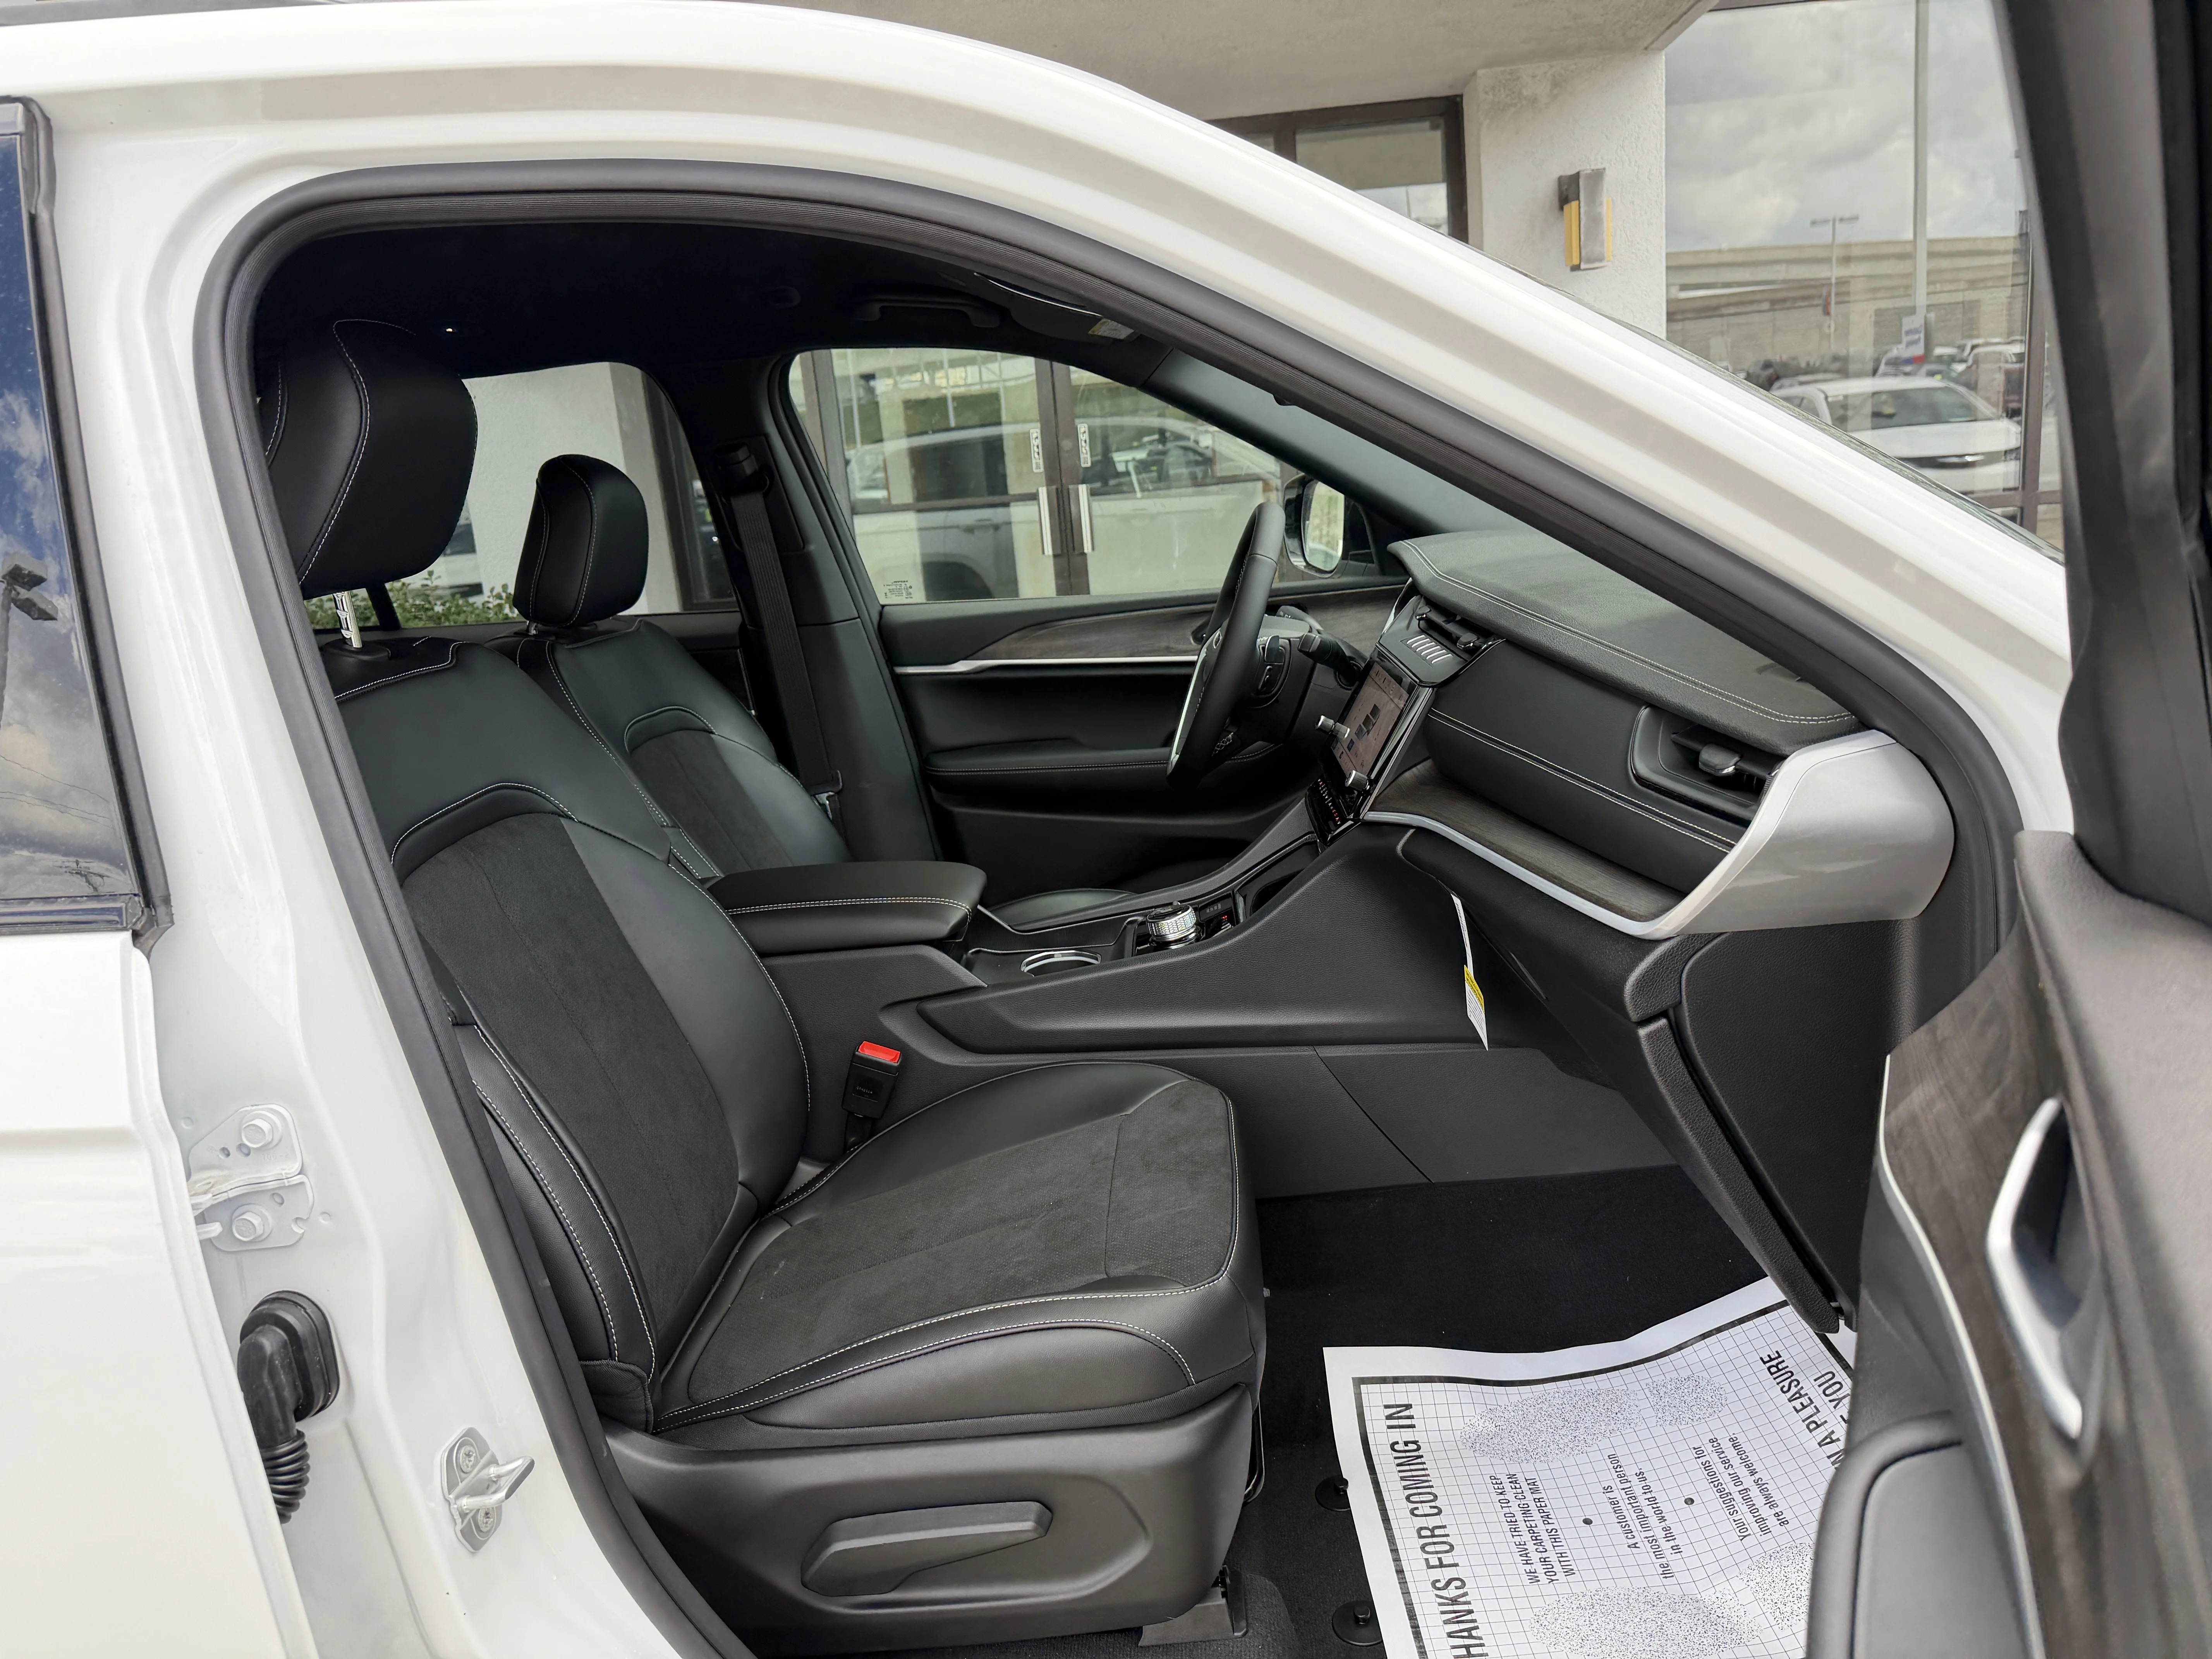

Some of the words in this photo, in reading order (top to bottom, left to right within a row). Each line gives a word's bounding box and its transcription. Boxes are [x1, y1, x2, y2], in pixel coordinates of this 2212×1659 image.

[1760, 1350, 1828, 1433] PLEASURE
[1814, 1371, 1850, 1409] YOU
[1383, 1403, 1416, 1429] IN
[1817, 1429, 1841, 1448] A
[1692, 1446, 1706, 1459] for
[1709, 1437, 1733, 1470] service
[1729, 1433, 1758, 1476] welcome.
[1390, 1440, 1443, 1517] COMING
[1608, 1454, 1632, 1484] person
[1635, 1468, 1647, 1482] us.
[1728, 1472, 1743, 1487] our
[1489, 1475, 1507, 1495] KEEP
[1506, 1474, 1526, 1500] CLEAN
[1525, 1477, 1542, 1494] MAT
[1602, 1485, 1614, 1494] is
[1642, 1484, 1653, 1495] to
[1701, 1460, 1738, 1516] suggestions
[1753, 1477, 1779, 1509] always
[1498, 1498, 1512, 1510] TO
[1534, 1497, 1555, 1525] PAPER
[1621, 1486, 1652, 1532] important
[1644, 1496, 1667, 1524] world
[1738, 1487, 1772, 1536] improving
[1504, 1513, 1523, 1539] TRIED
[1518, 1503, 1548, 1553] CARPETING
[1608, 1497, 1635, 1540] customer
[1733, 1518, 1751, 1541] Your
[1774, 1511, 1789, 1527] are
[1416, 1524, 1460, 1569] FOR
[1546, 1528, 1564, 1549] THIS
[1644, 1535, 1665, 1559] most
[1662, 1526, 1676, 1542] the
[1514, 1541, 1534, 1565] HAVE
[1670, 1544, 1683, 1555] in
[1524, 1568, 1540, 1583] WE
[1539, 1556, 1559, 1583] YOUR
[1556, 1552, 1576, 1577] WITH
[1659, 1563, 1674, 1579] the
[1431, 1577, 1489, 1659] HANKS
